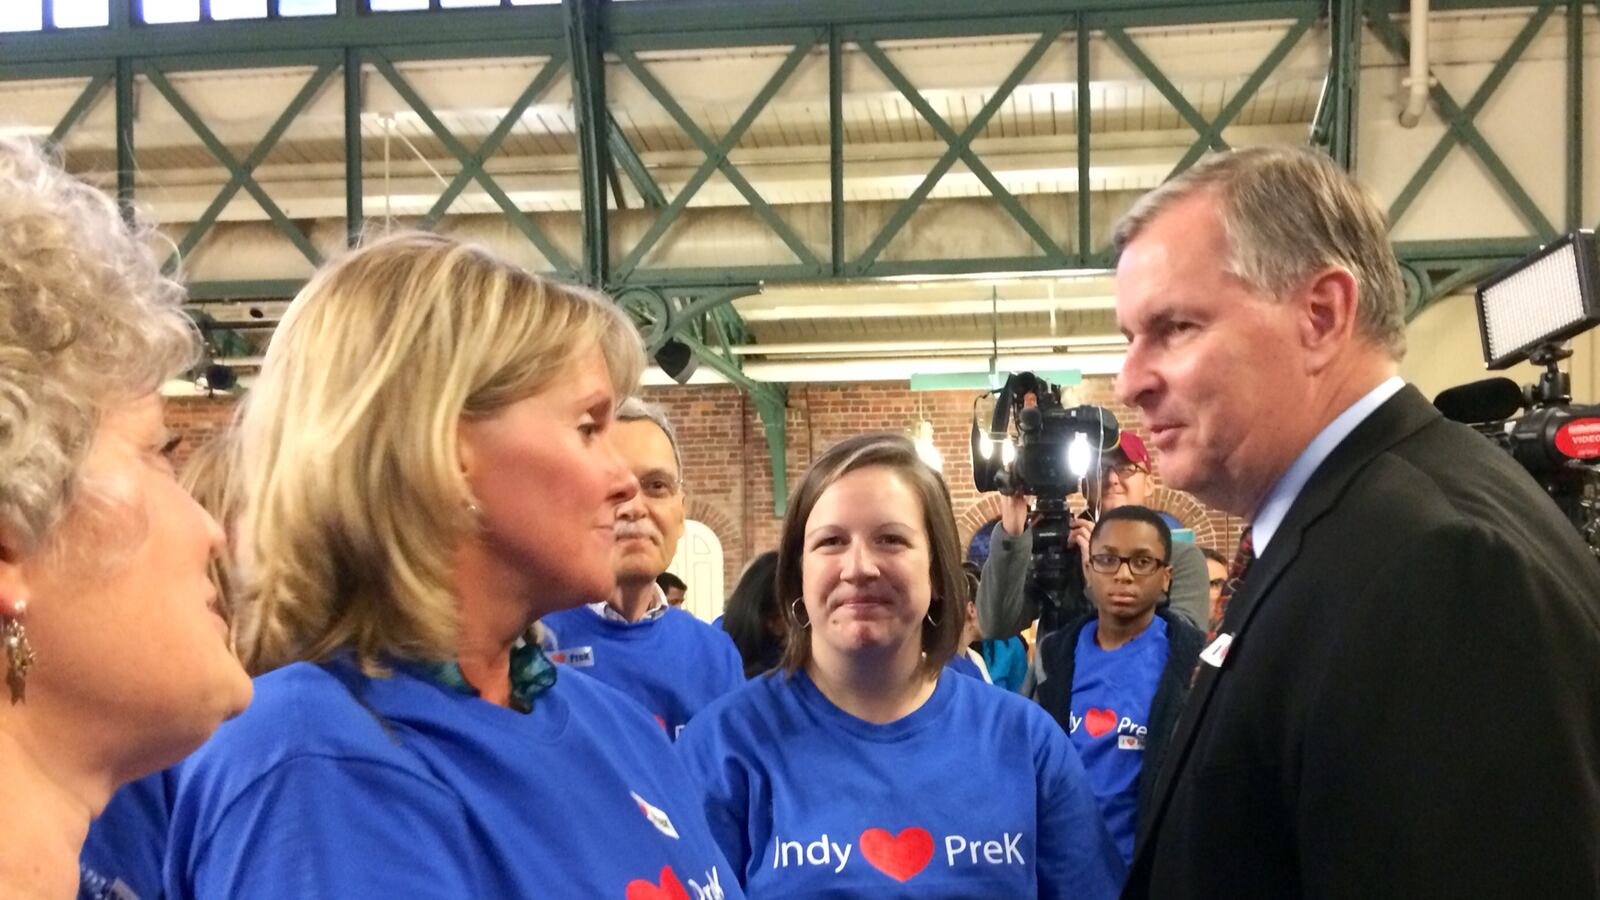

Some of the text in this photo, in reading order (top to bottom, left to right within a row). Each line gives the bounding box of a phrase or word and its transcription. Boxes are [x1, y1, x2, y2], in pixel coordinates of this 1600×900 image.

[1571, 434, 1600, 445] VIDEO
[773, 832, 1025, 873] Indy PreK
